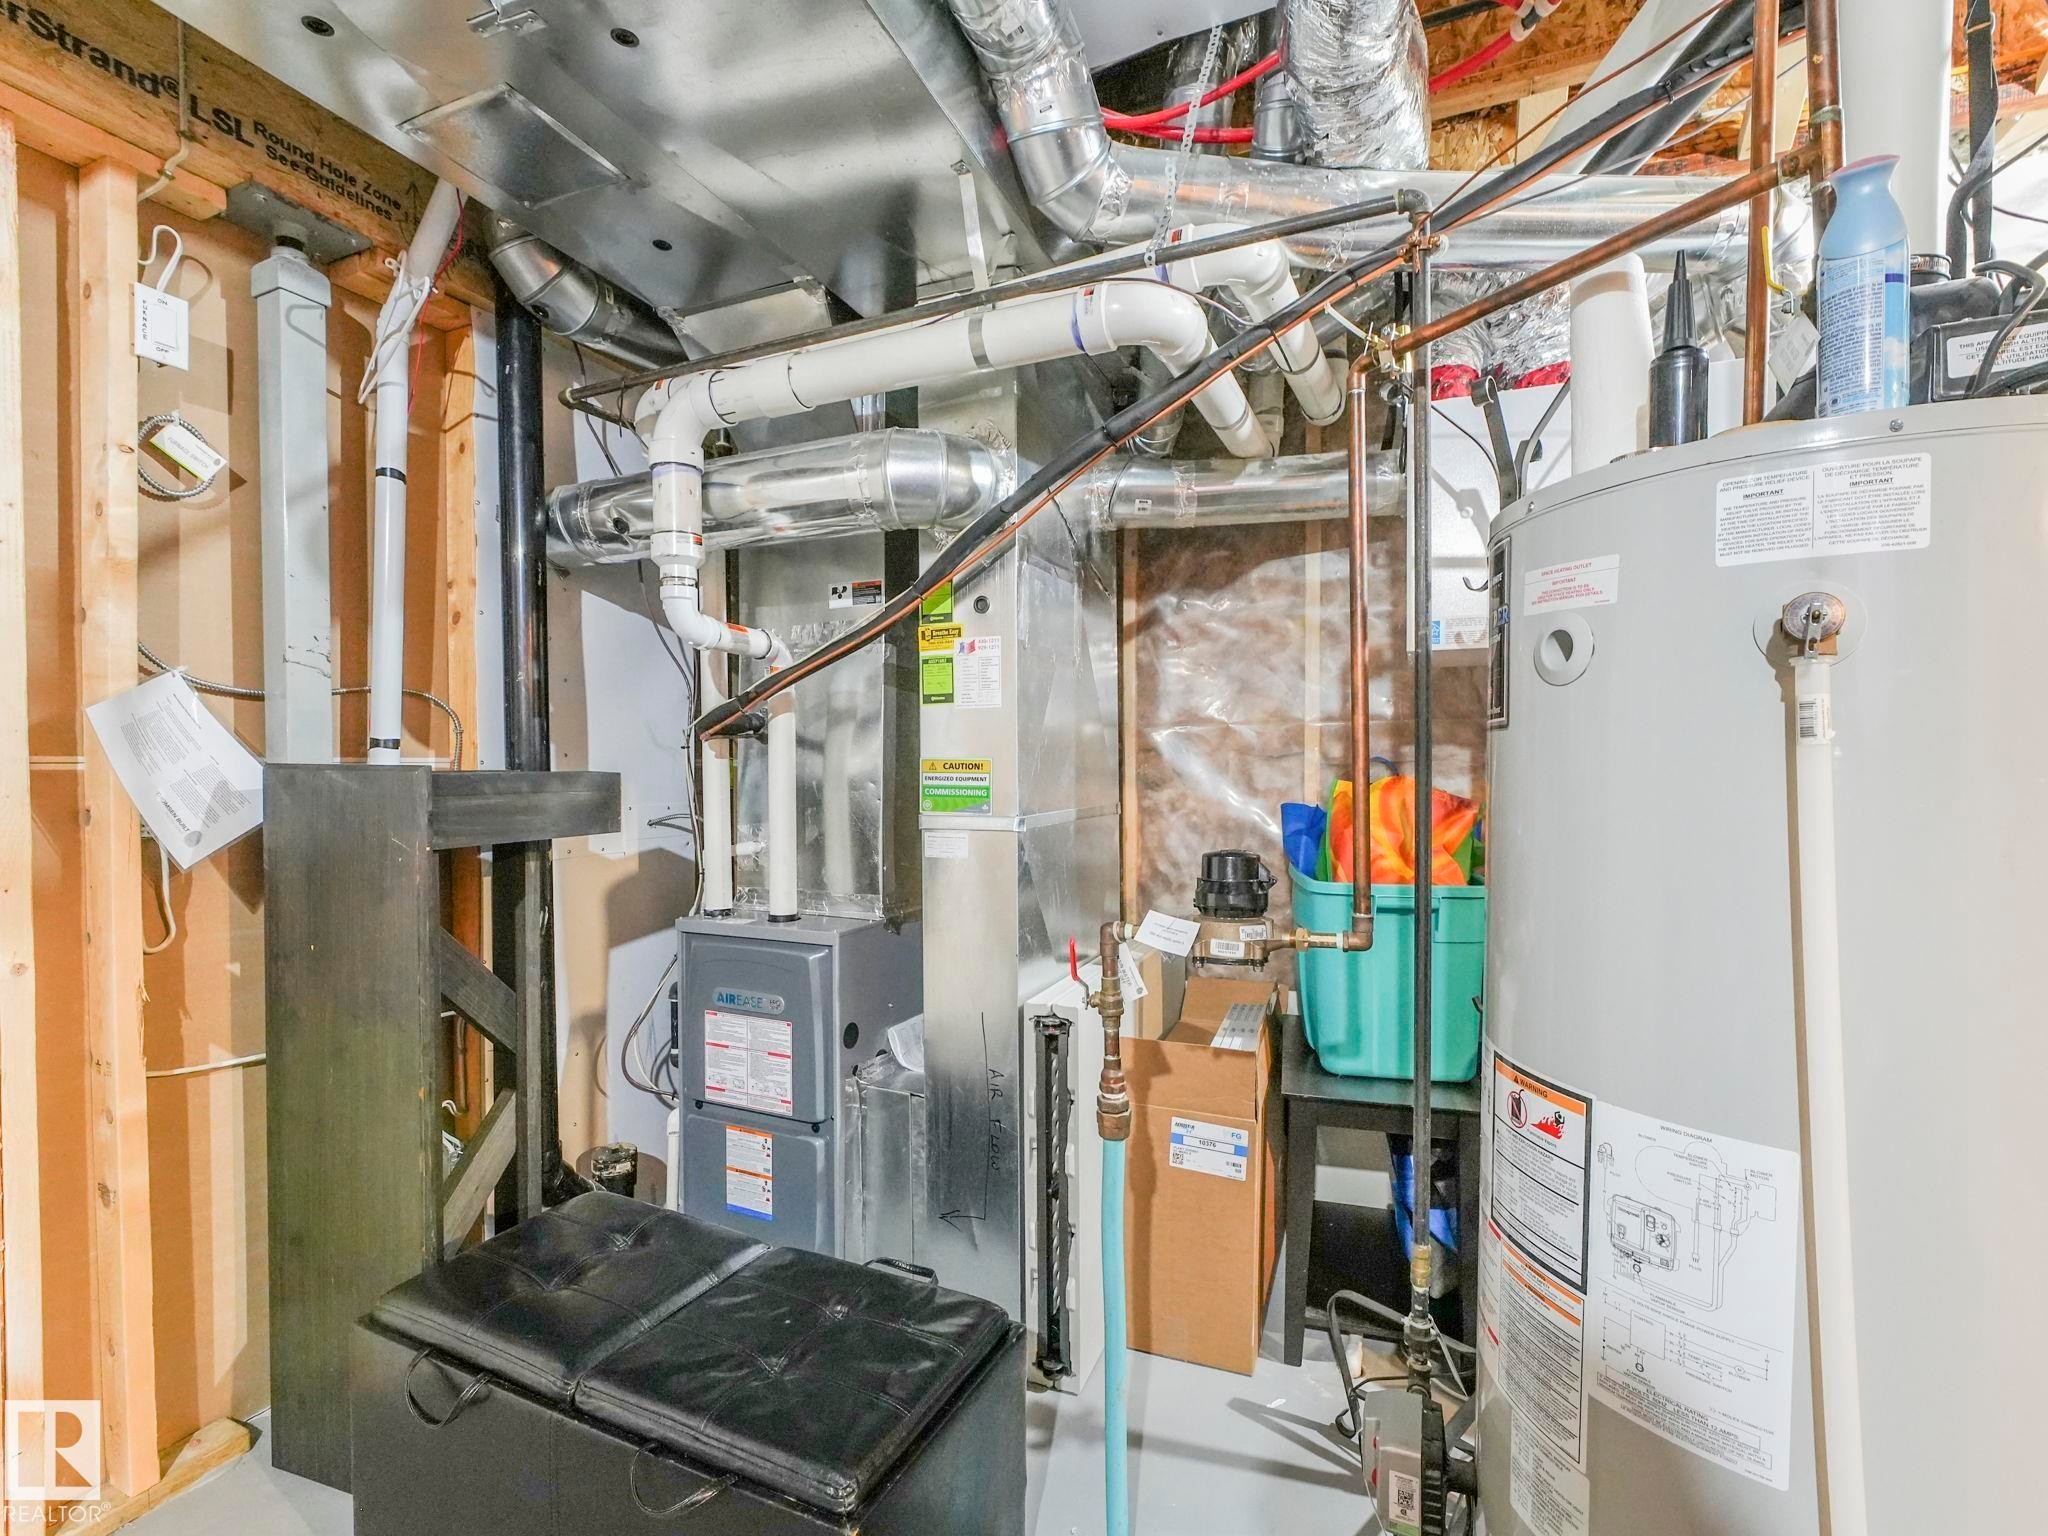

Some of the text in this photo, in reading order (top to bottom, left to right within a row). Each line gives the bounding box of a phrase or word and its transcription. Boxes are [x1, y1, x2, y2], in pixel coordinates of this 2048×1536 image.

[190, 94, 254, 148] LSL
[254, 120, 401, 210] Round Hole Zone
[265, 144, 301, 171] See
[305, 165, 392, 221] Guidelines
[157, 298, 168, 306] ON
[1850, 478, 1893, 487] IMPORTANT
[1743, 489, 1784, 499] IMPORTANT
[1554, 565, 1572, 574] HEATING
[925, 788, 987, 796] COMMISSIONING
[716, 992, 763, 1009] AIREASE
[1520, 1079, 1548, 1098] WARNING
[988, 1068, 1004, 1172] AIR FLOW
[1684, 1132, 1712, 1143] DIAGRAM
[1692, 1417, 1708, 1427] THAN
